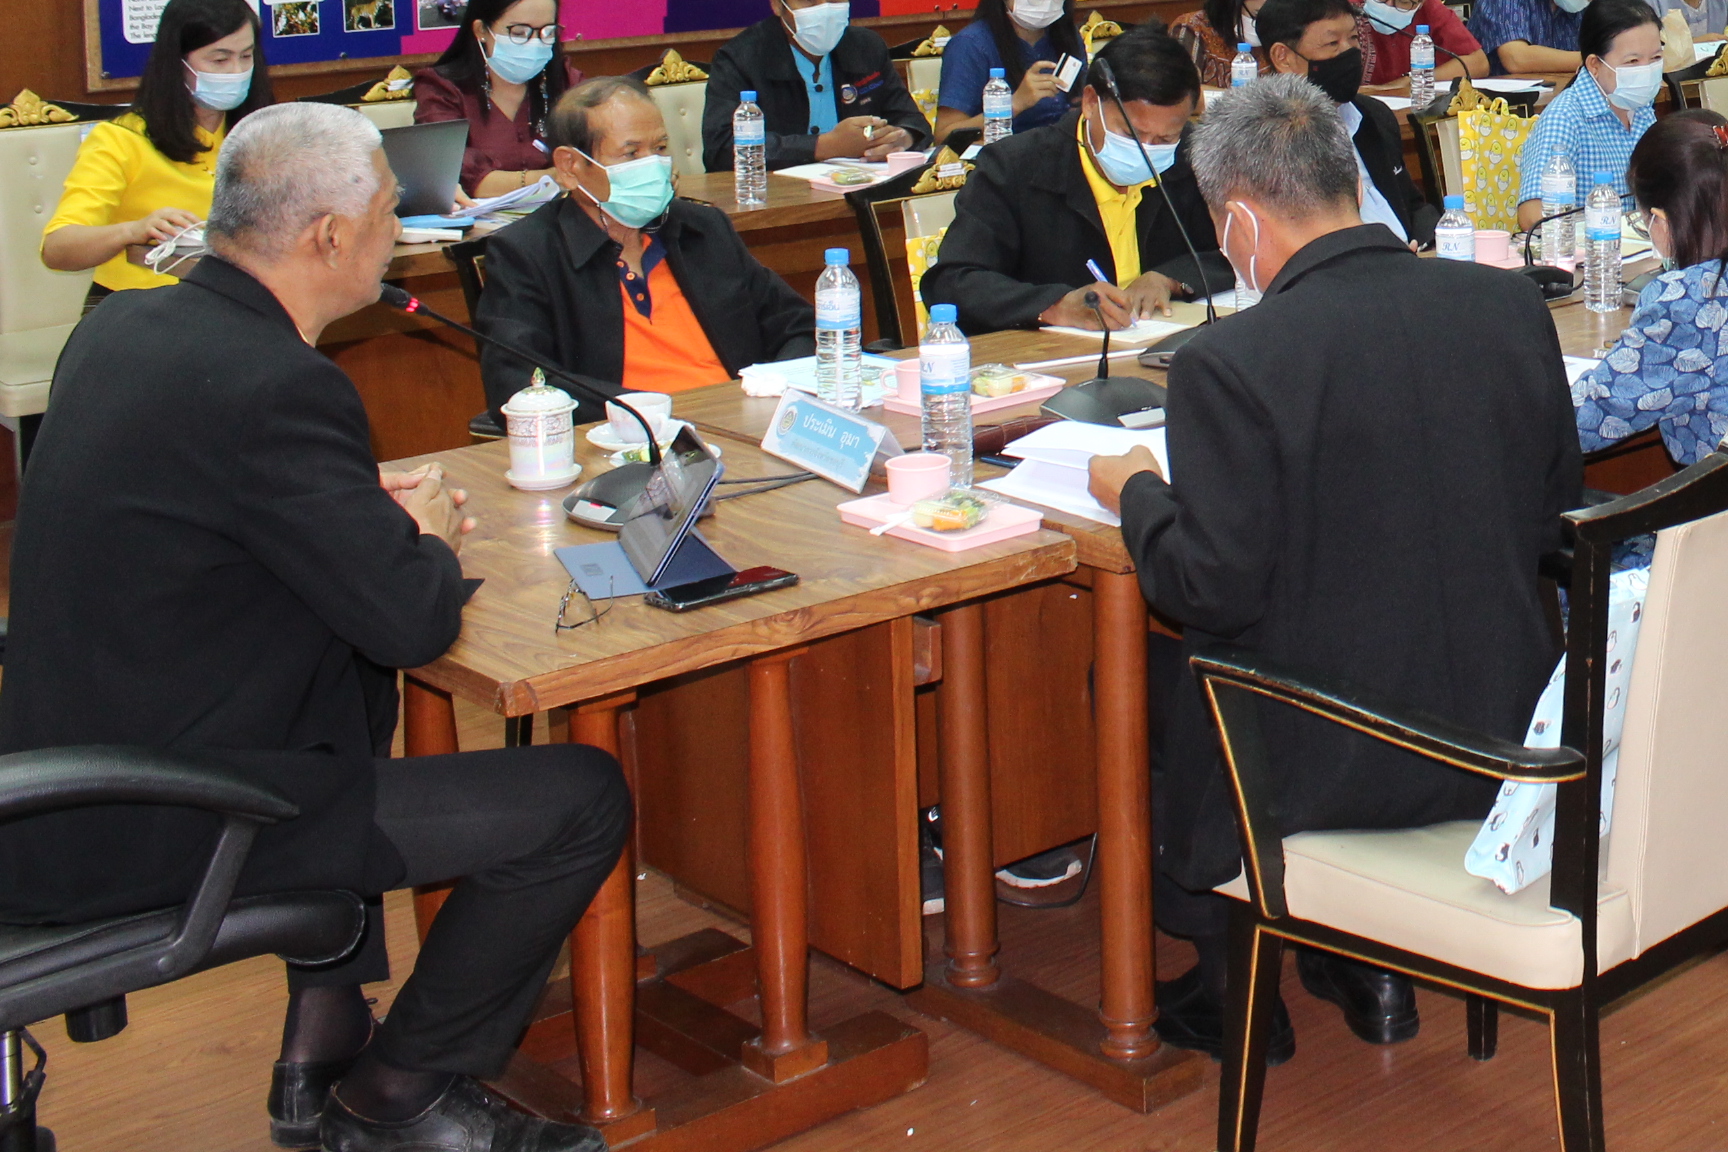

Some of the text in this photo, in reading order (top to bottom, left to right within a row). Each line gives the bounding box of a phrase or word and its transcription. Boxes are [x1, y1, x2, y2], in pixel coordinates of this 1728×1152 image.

[803, 414, 860, 449] ประเมิน อุมา
